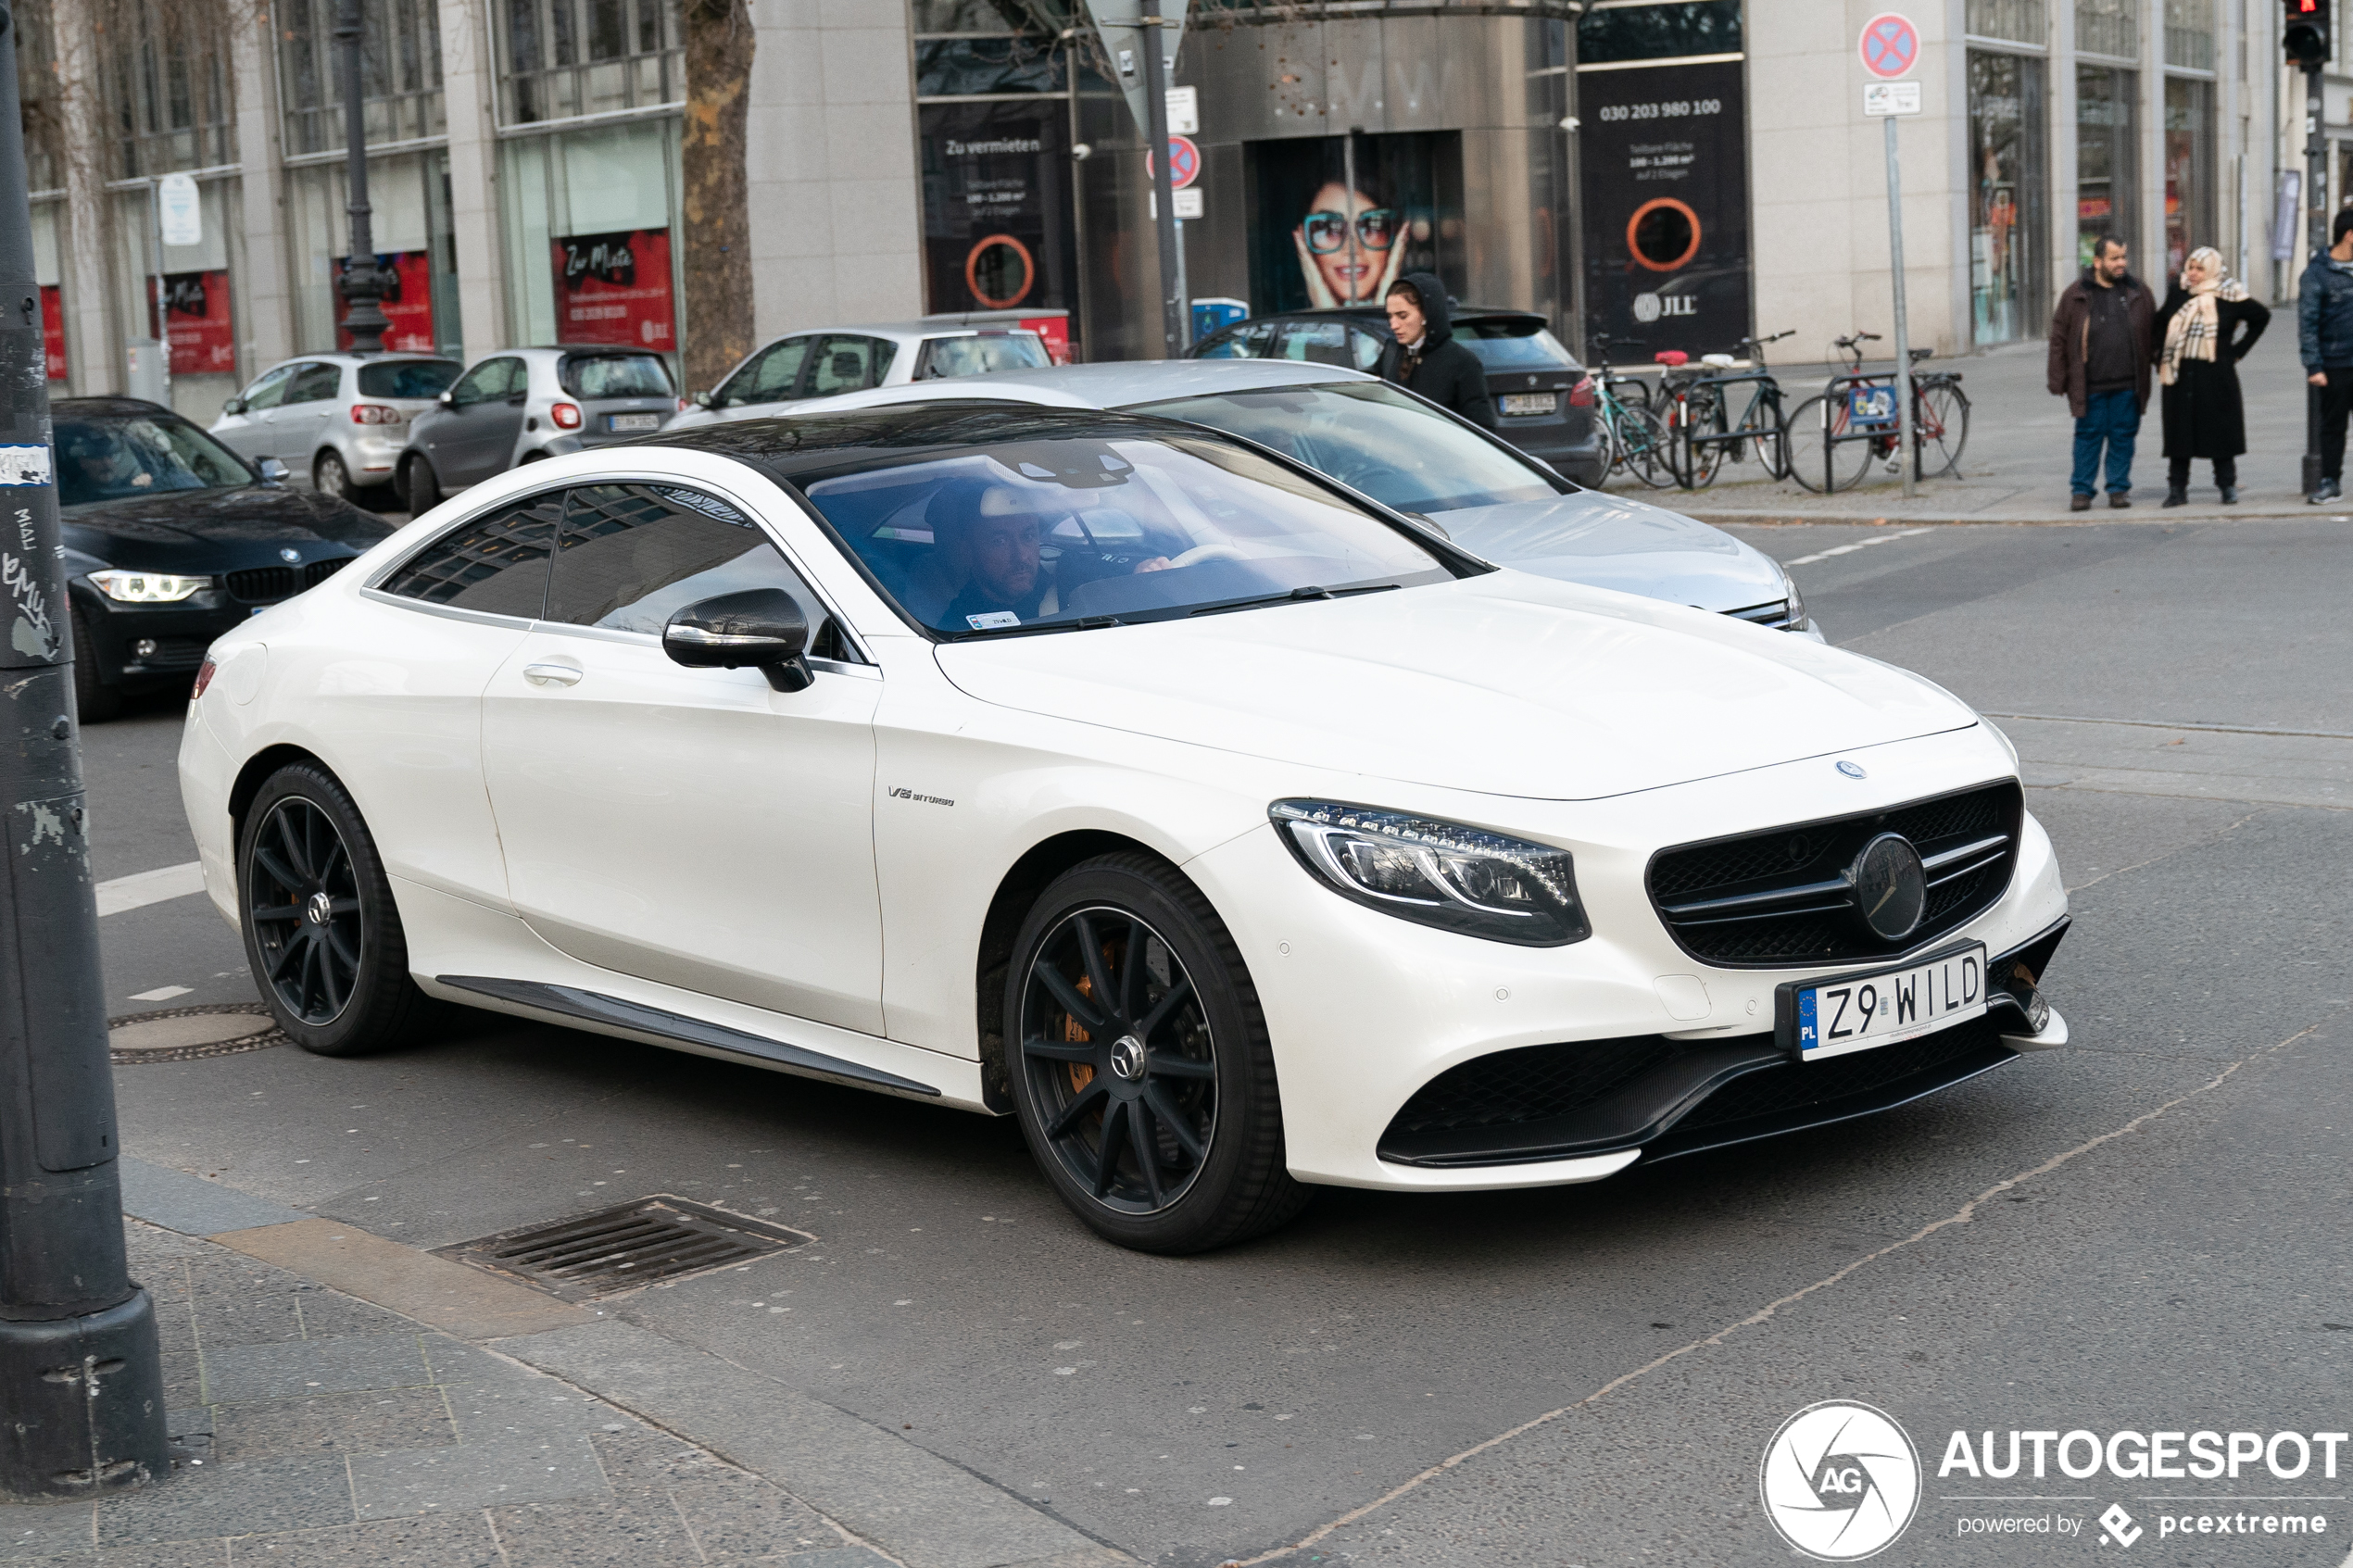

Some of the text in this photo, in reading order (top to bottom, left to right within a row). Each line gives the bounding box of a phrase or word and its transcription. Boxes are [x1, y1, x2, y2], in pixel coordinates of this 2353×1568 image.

[1600, 98, 1721, 121] 030 203 980 100
[946, 136, 1040, 155] Zu vermieten
[1661, 295, 1697, 317] JLL
[912, 794, 954, 807] BITURBO
[1826, 955, 1979, 1040] Z9 WILD
[1801, 1025, 1817, 1041] PL
